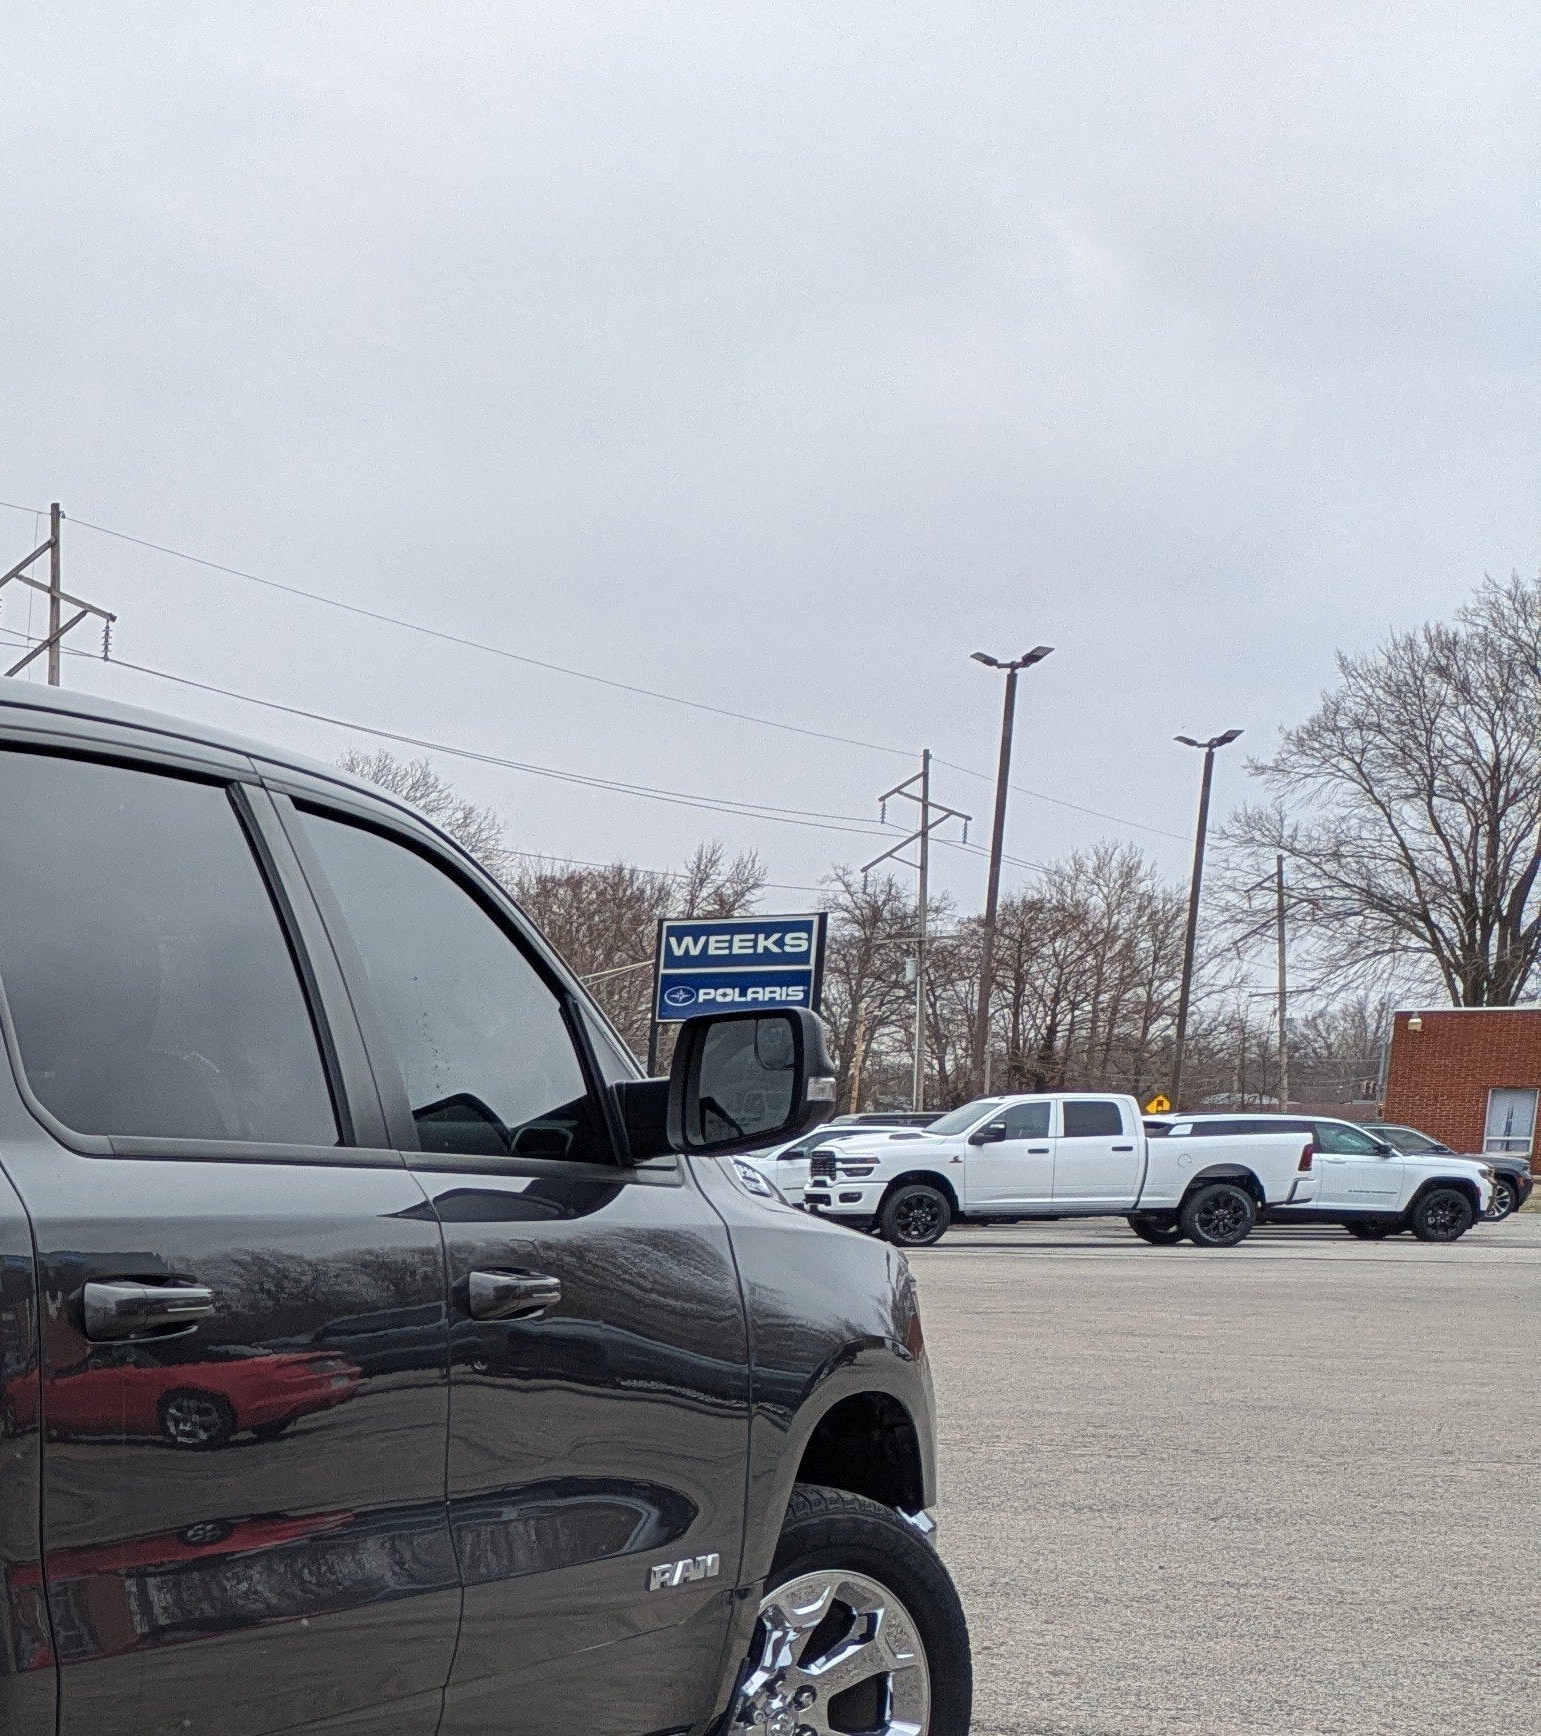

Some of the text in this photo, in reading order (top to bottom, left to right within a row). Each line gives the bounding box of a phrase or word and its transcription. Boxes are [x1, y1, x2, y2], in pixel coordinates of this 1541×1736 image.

[669, 931, 809, 957] WEEKS
[697, 985, 805, 1003] POLARIS
[647, 1552, 720, 1592] RAM
